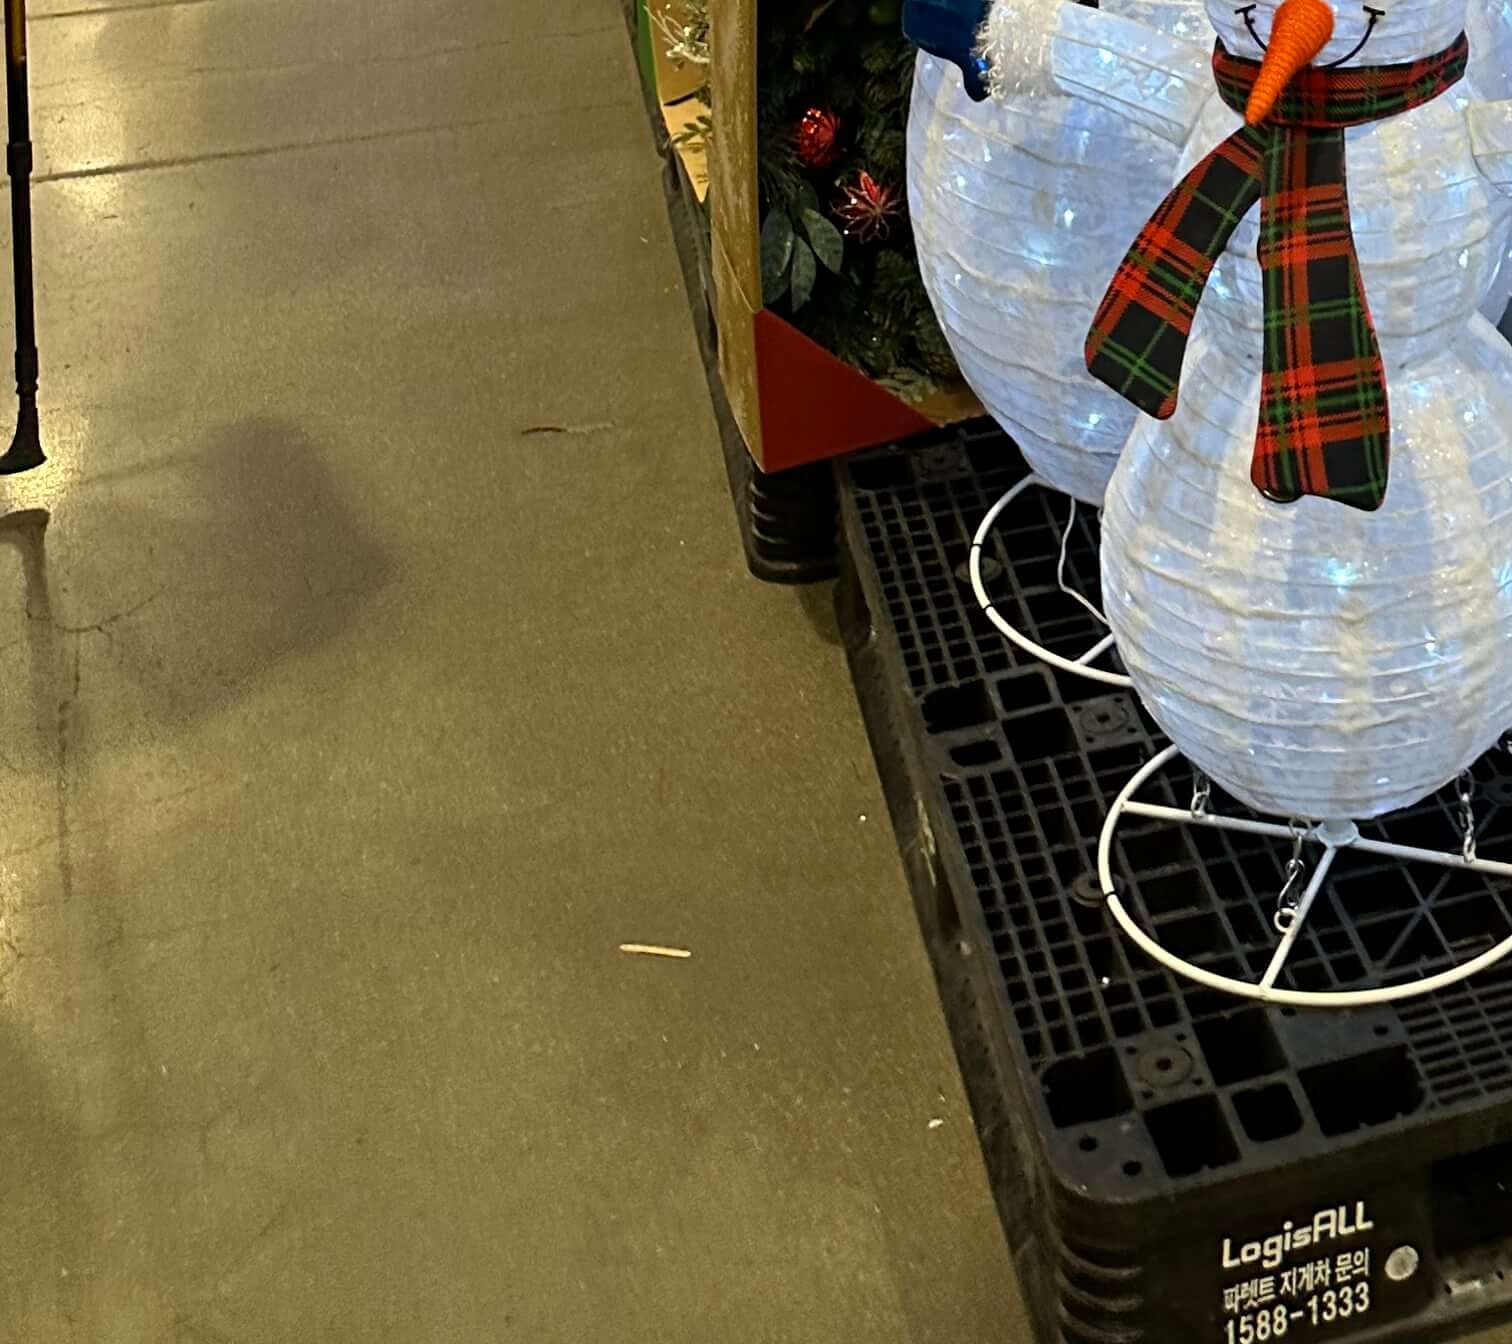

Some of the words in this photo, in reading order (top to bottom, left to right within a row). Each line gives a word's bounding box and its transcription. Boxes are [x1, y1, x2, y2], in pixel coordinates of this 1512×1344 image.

[1221, 1200, 1374, 1269] LogisALL
[1279, 1257, 1331, 1297] 지게차
[1334, 1246, 1370, 1284] 문의
[1223, 1281, 1370, 1344] 1588-1333
